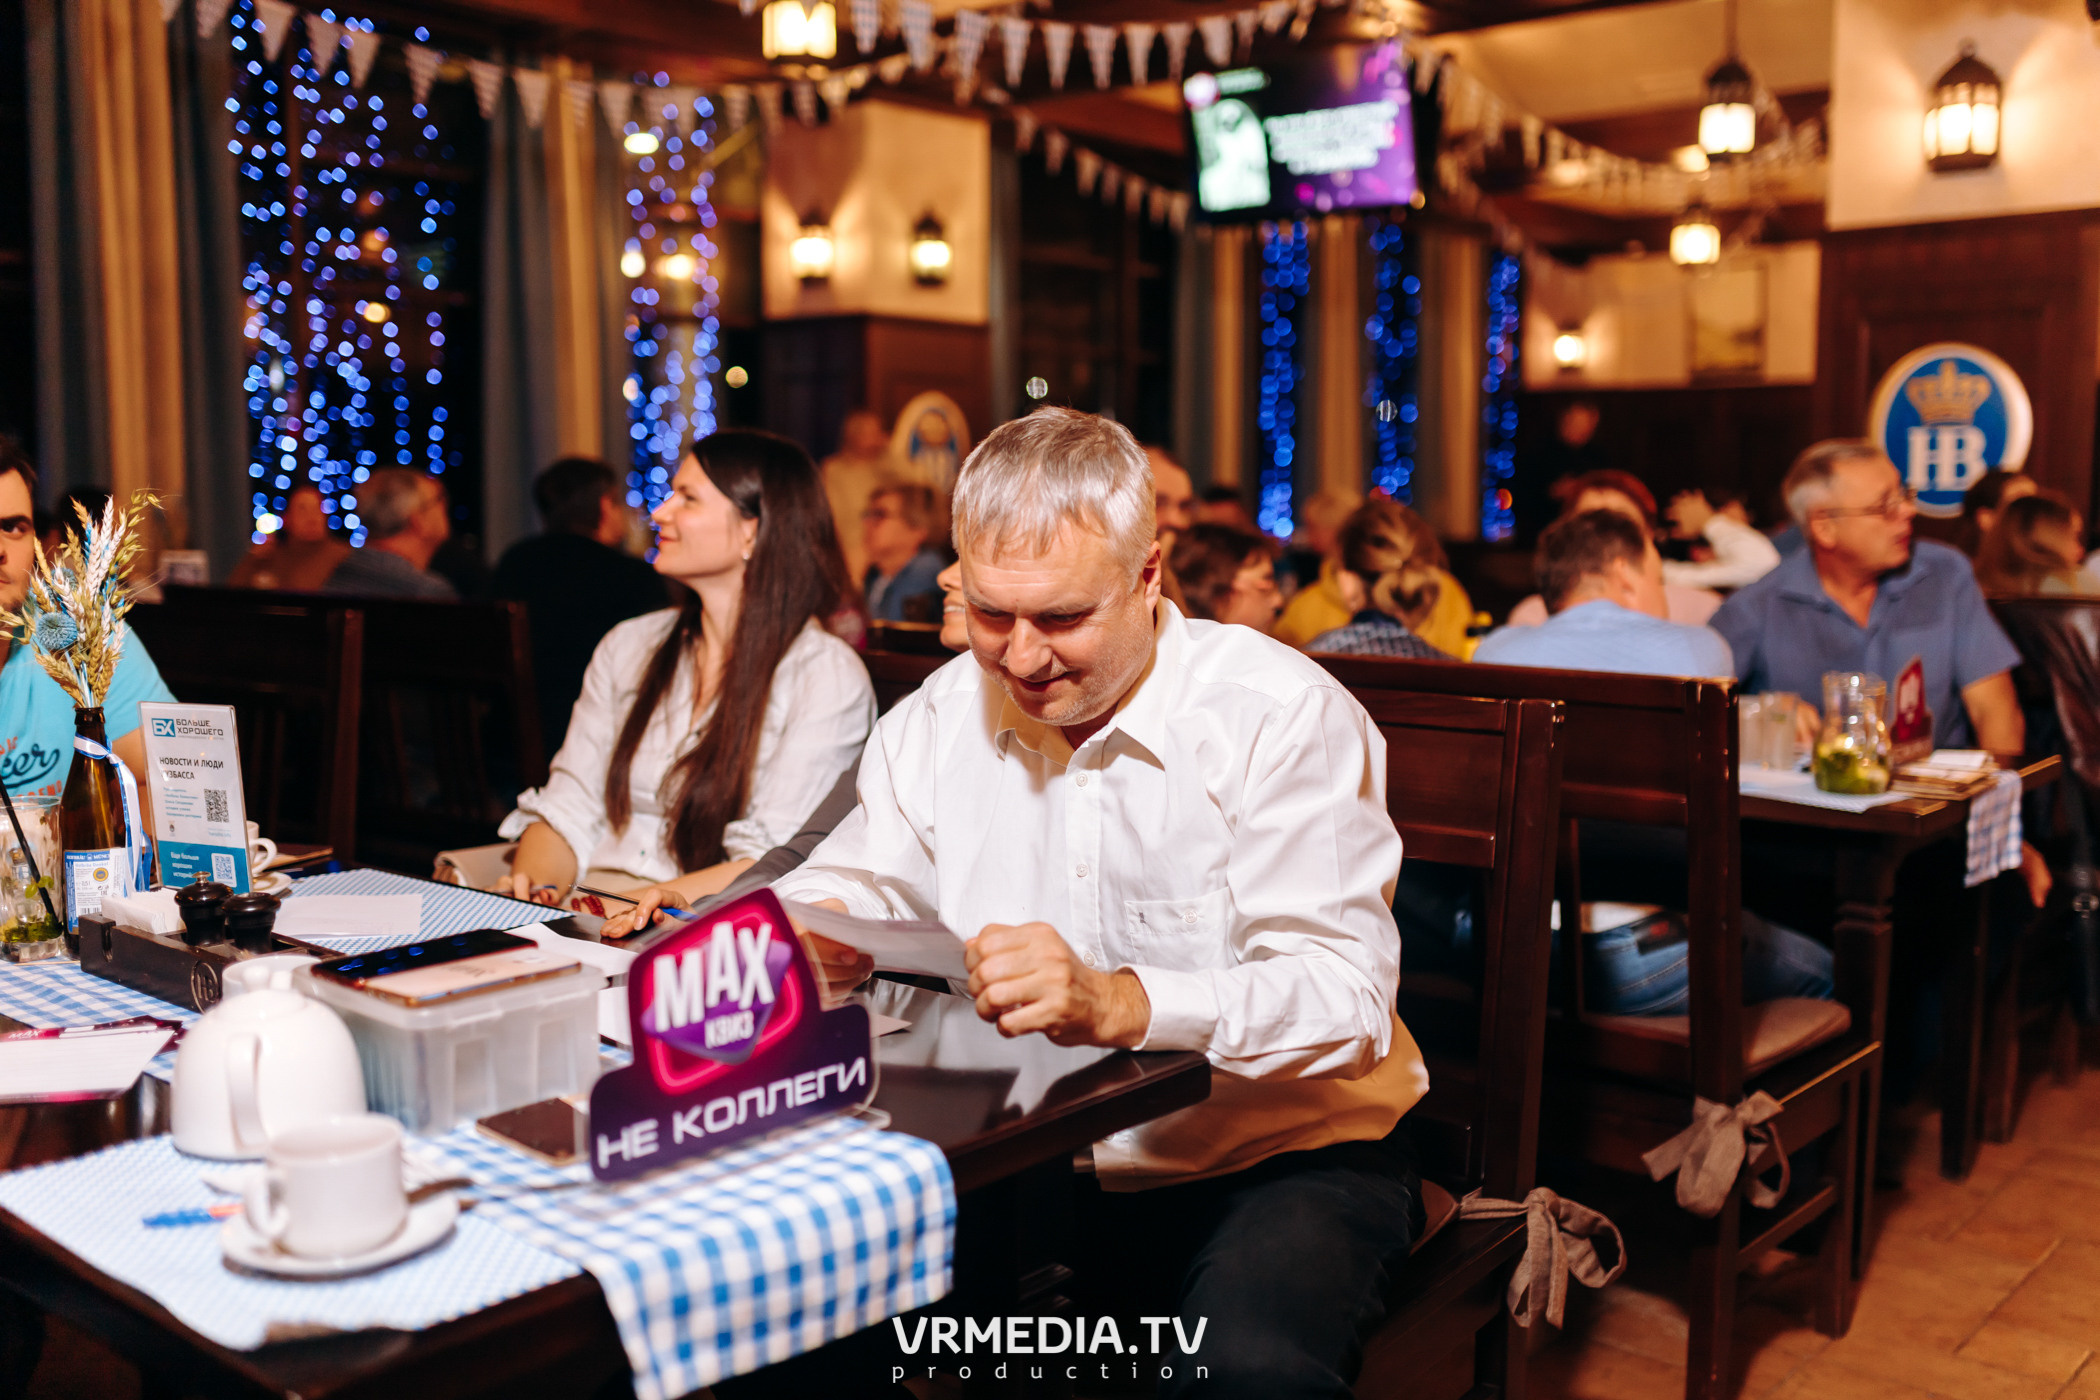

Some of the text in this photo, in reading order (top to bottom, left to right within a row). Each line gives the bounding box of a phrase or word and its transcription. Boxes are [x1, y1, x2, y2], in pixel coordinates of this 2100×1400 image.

[907, 426, 987, 492] HB
[176, 718, 211, 728] БОЛЬШЕ
[177, 727, 224, 737] ХОРОШЕГО
[159, 757, 224, 769] НОВОСТИ И ЛЮДИ
[653, 920, 776, 1033] MAX
[597, 1056, 867, 1169] НЕ КОЛЛЕГИ
